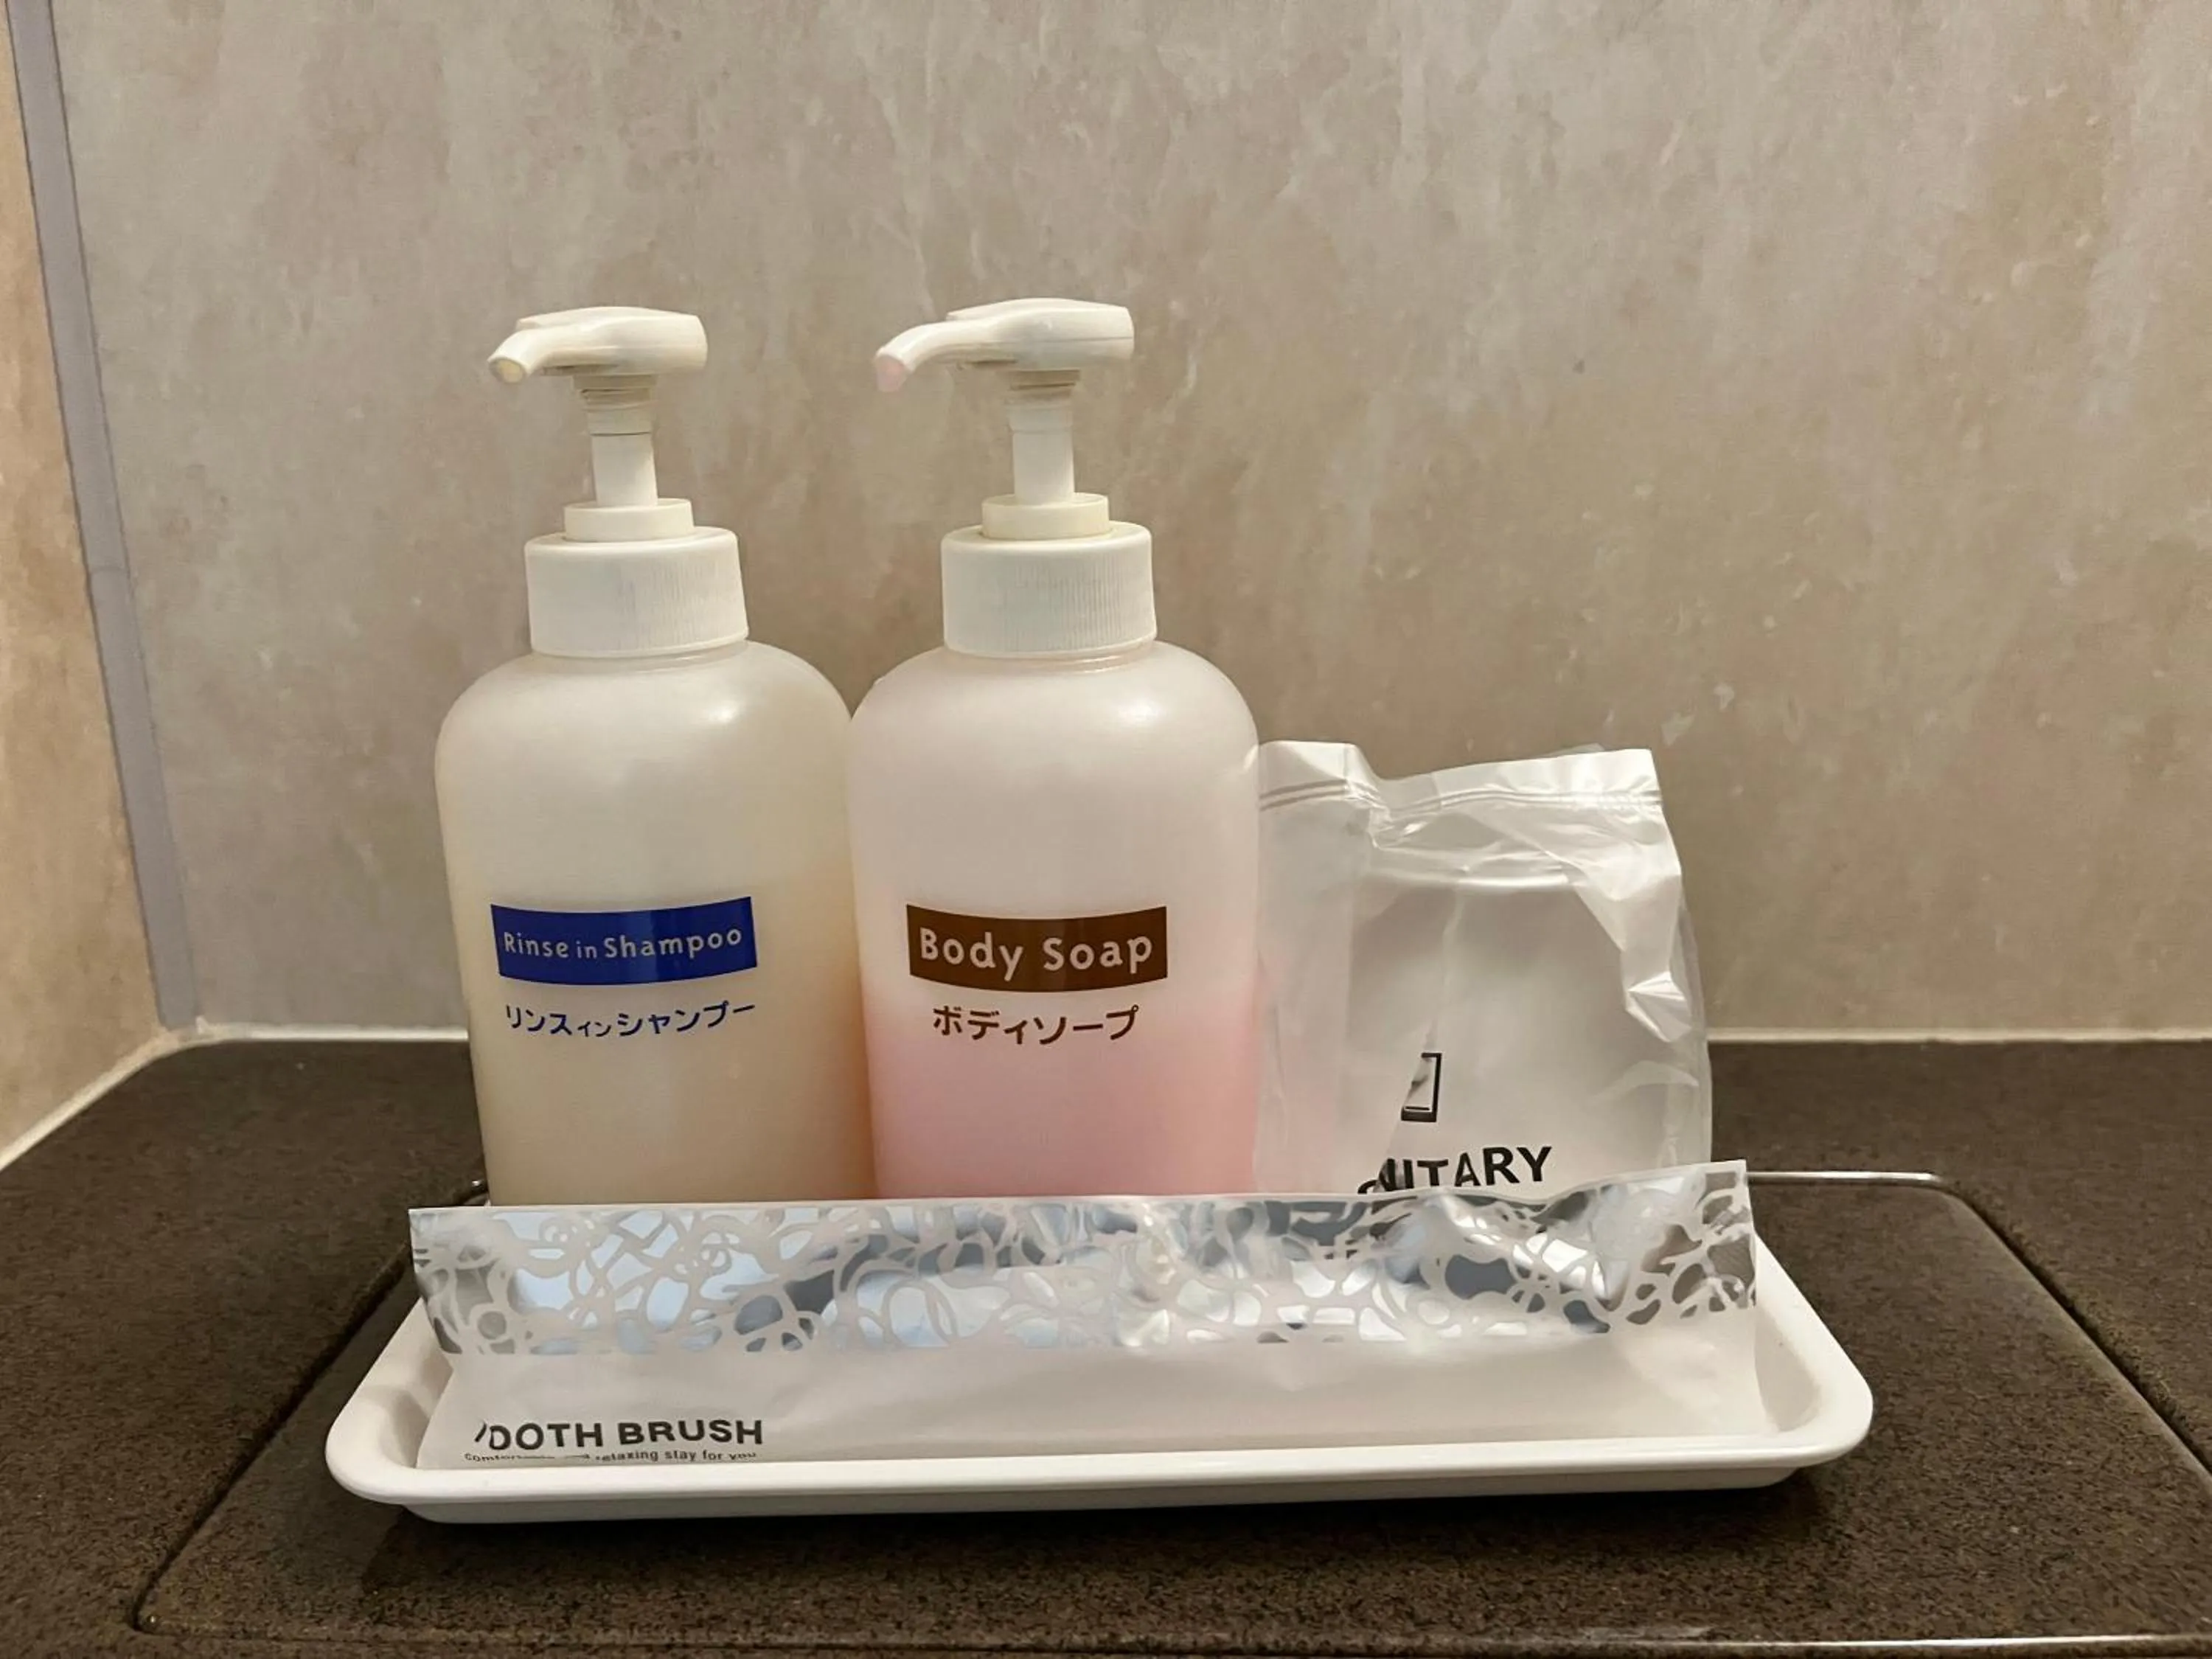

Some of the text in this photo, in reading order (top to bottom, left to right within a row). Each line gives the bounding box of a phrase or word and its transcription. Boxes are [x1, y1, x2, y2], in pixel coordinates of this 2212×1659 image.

[504, 928, 742, 959] Rinse in Shampoo
[919, 928, 1152, 981] Body Soap
[933, 1004, 1139, 1046] ボディソープ
[618, 1419, 762, 1445] BRUSH
[664, 1450, 695, 1461] stay
[703, 1449, 723, 1461] for
